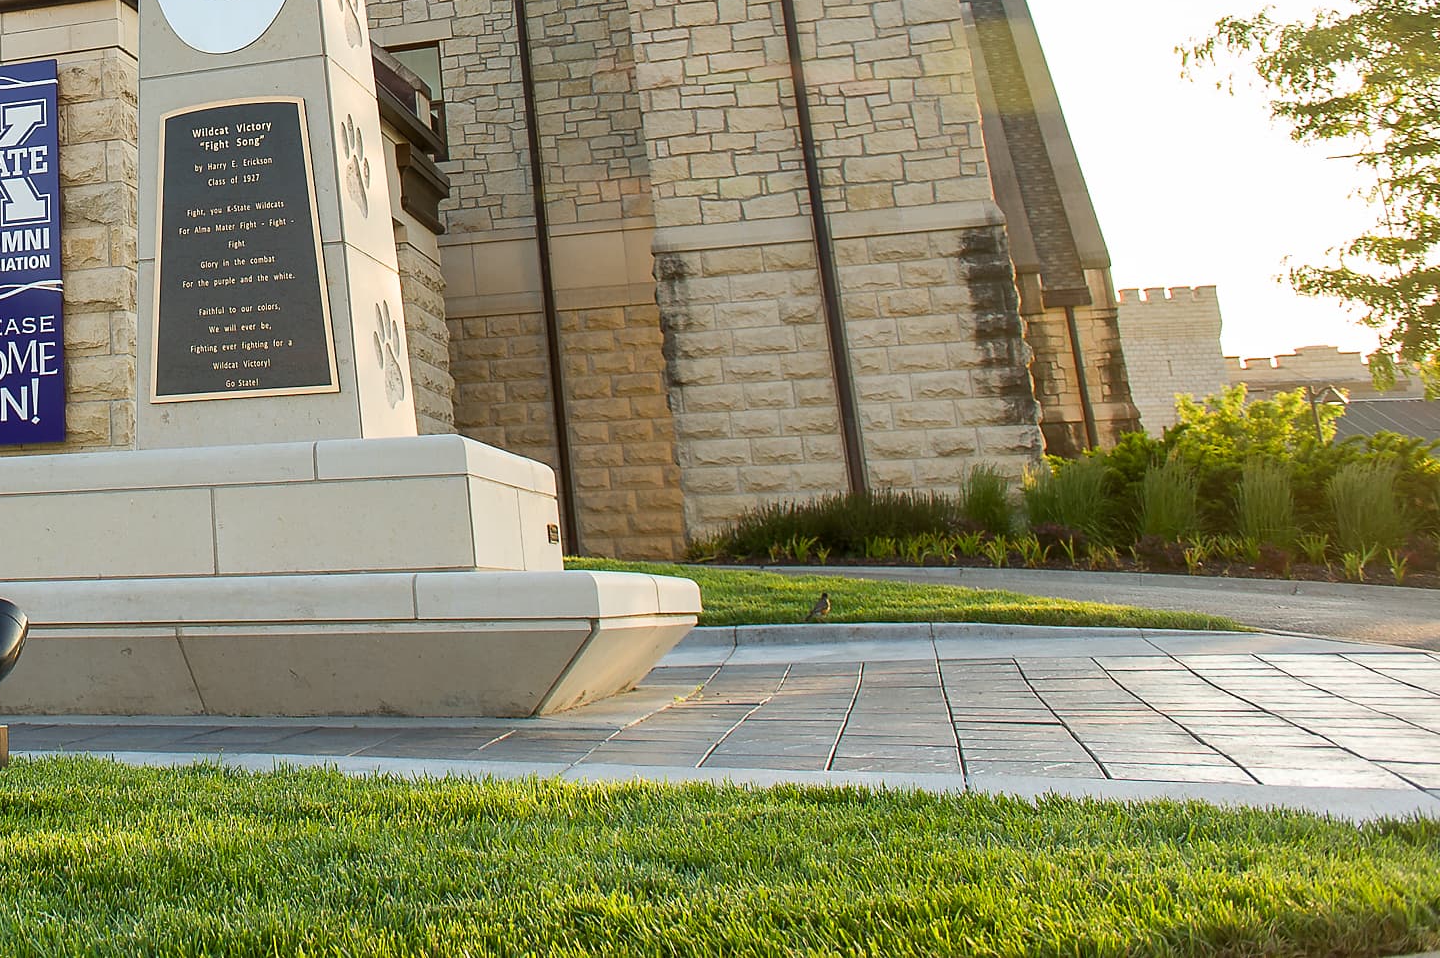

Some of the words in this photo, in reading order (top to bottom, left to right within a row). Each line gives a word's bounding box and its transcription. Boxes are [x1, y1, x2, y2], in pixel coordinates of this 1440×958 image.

[192, 126, 229, 138] Wildcat
[236, 122, 272, 133] Victory
[194, 164, 203, 173] by
[207, 161, 227, 171] Harry
[231, 160, 238, 168] E.
[243, 157, 273, 167] Erickson
[207, 178, 226, 187] Class
[230, 176, 238, 184] of
[243, 173, 260, 183] 1927
[187, 208, 206, 218] Fight,
[210, 208, 223, 216] you
[226, 204, 251, 213] K-State
[255, 200, 284, 210] Wildcats
[178, 227, 190, 235] For
[194, 225, 211, 234] Alma
[215, 224, 236, 232] Mater
[240, 220, 257, 230] Fight
[269, 218, 286, 227] Fight
[228, 240, 246, 249] Fight
[200, 260, 219, 269] Glory
[223, 259, 230, 267] in
[234, 257, 246, 266] the
[250, 255, 276, 264] combat
[182, 280, 193, 288] For
[198, 279, 209, 287] the
[213, 277, 236, 287] purple
[240, 275, 253, 283] and
[257, 273, 269, 282] the
[198, 306, 225, 316] Faithful
[229, 306, 237, 314] to
[241, 305, 253, 313] our
[208, 325, 220, 334] We
[223, 324, 237, 332] will
[241, 323, 256, 331] ever
[190, 344, 218, 354] Fighting
[222, 343, 237, 351] ever
[241, 340, 269, 350] fighting
[273, 339, 284, 347] for
[212, 361, 239, 370] Wildcat
[225, 379, 235, 387] Go
